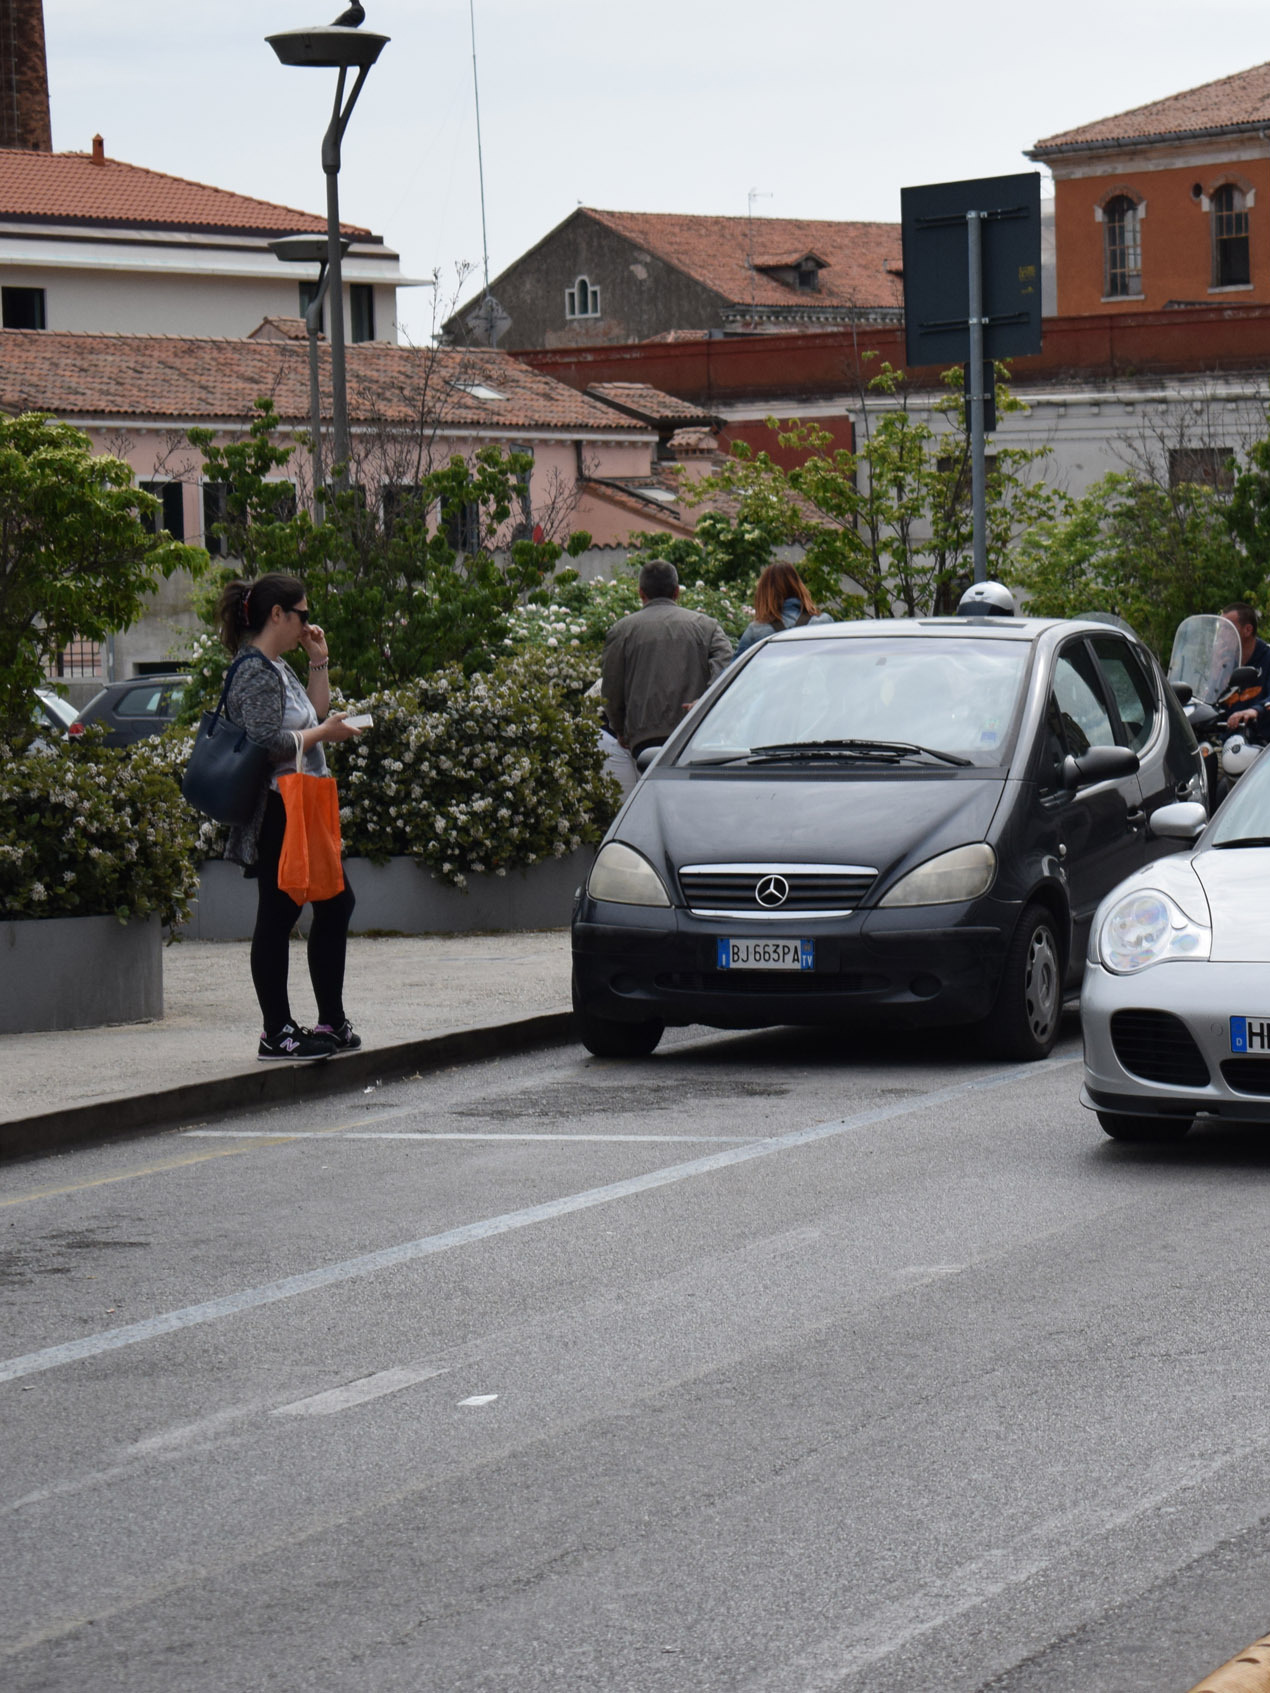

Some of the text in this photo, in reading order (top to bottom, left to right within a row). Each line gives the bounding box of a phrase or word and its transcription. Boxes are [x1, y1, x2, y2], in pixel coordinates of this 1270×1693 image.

[731, 943, 800, 963] BJ 663PA
[802, 955, 813, 967] TV
[280, 1037, 300, 1052] N
[1236, 1038, 1243, 1046] D
